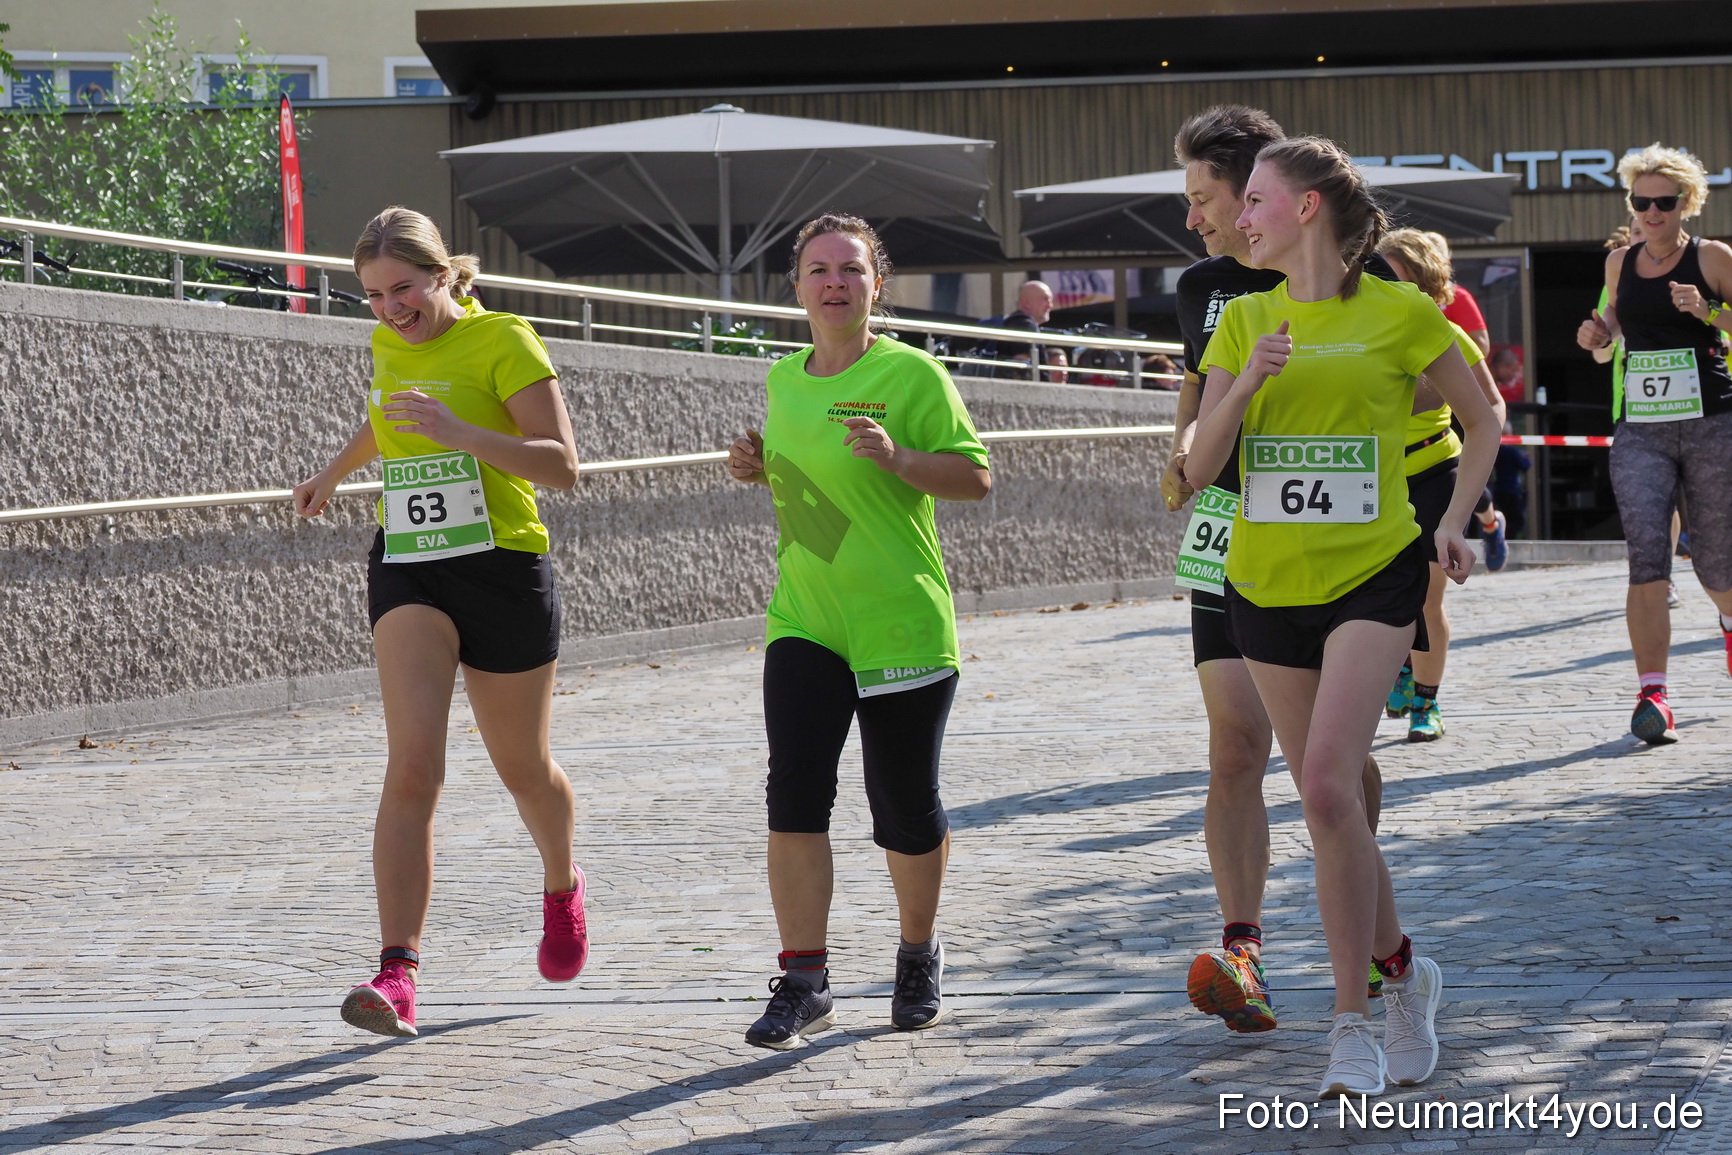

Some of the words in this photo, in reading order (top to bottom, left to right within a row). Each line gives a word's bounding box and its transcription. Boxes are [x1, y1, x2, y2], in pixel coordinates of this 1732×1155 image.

[1630, 352, 1690, 371] BOCK
[1643, 376, 1671, 398] 67
[827, 408, 888, 420] ELEMENTELAUF
[833, 401, 887, 411] NEUMARKTER
[1631, 401, 1693, 412] ANNA-MARIA
[1254, 441, 1367, 468] BOCK
[388, 455, 470, 488] BOCK
[1280, 479, 1333, 515] 64
[407, 491, 448, 526] 63
[416, 533, 449, 549] EVA
[1192, 521, 1229, 557] 94
